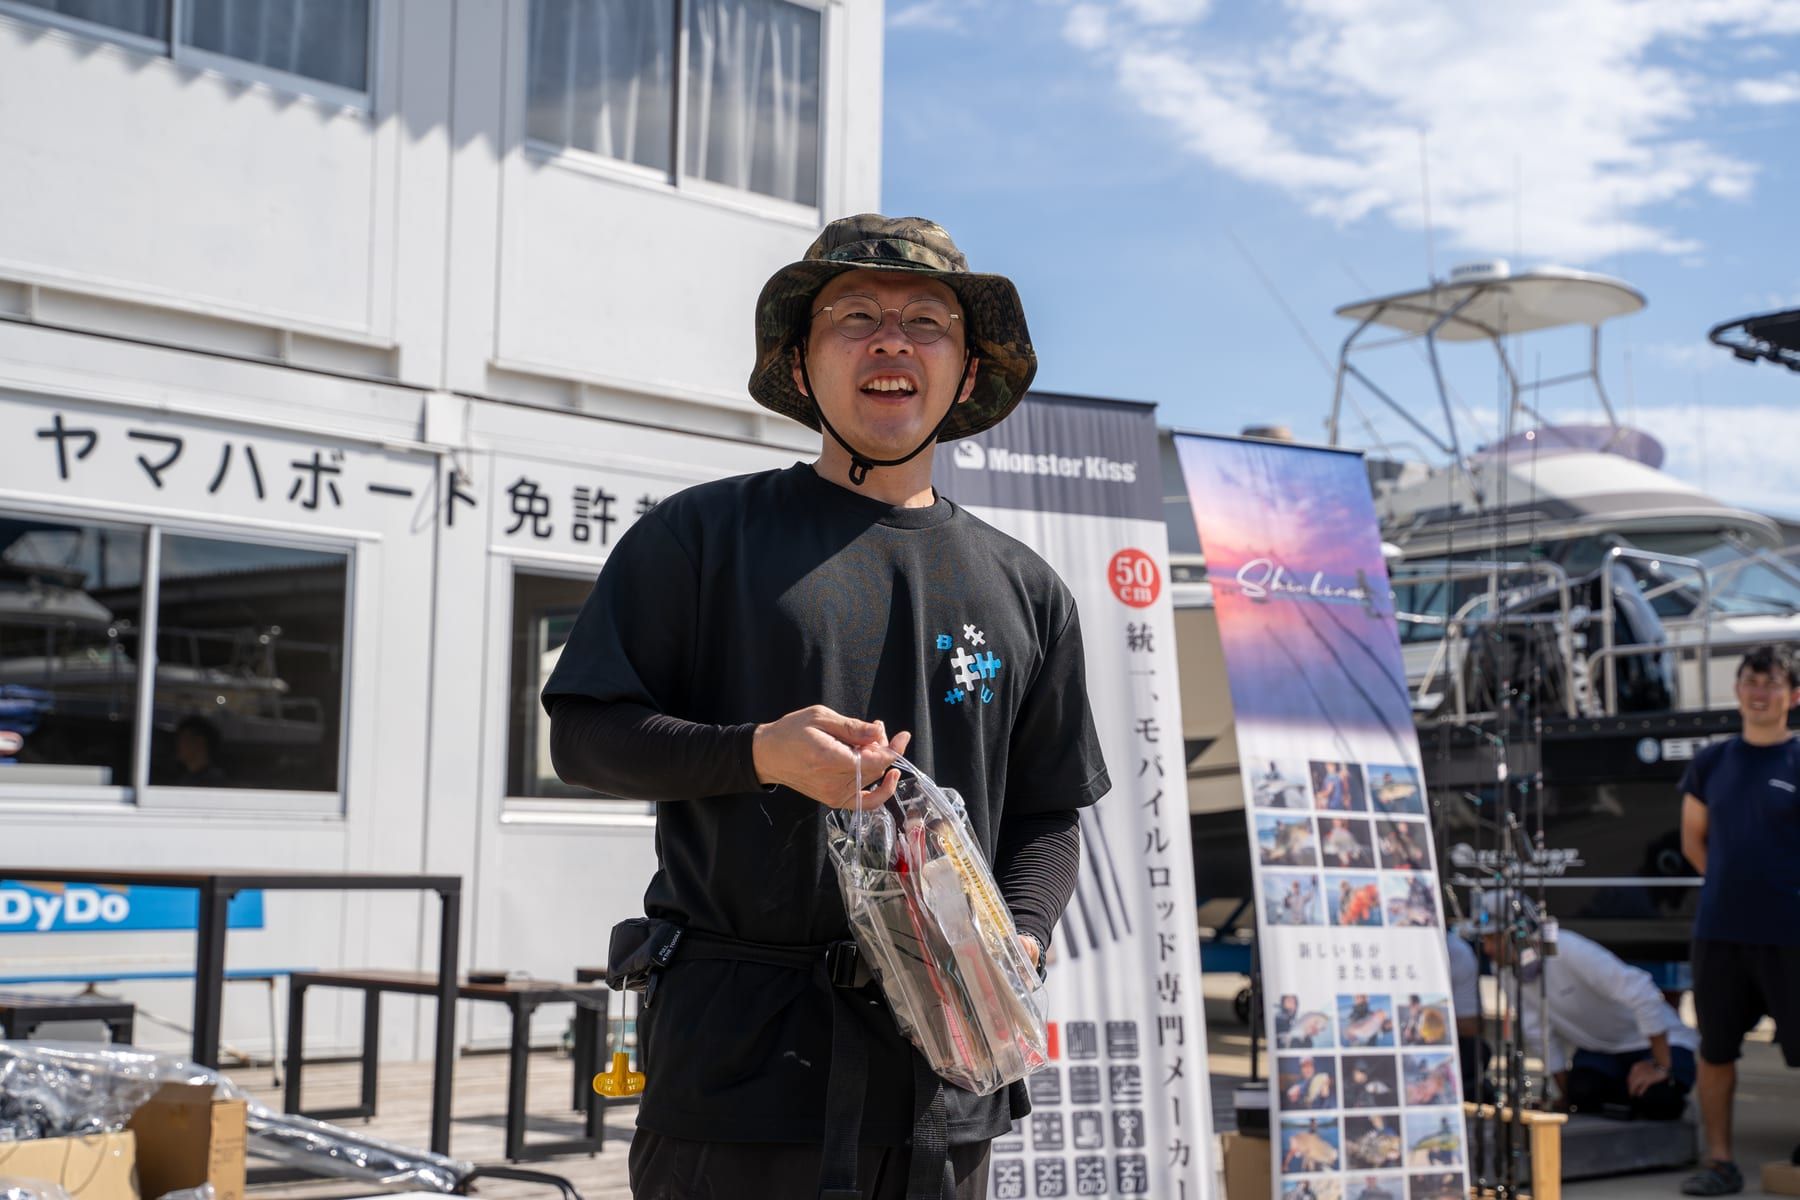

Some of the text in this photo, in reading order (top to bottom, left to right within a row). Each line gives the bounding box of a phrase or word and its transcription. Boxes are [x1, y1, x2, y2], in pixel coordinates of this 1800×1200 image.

[988, 447, 1136, 483] Monster Kiss
[1116, 557, 1154, 586] 50
[1120, 587, 1151, 602] cm
[0, 888, 130, 930] DyDo
